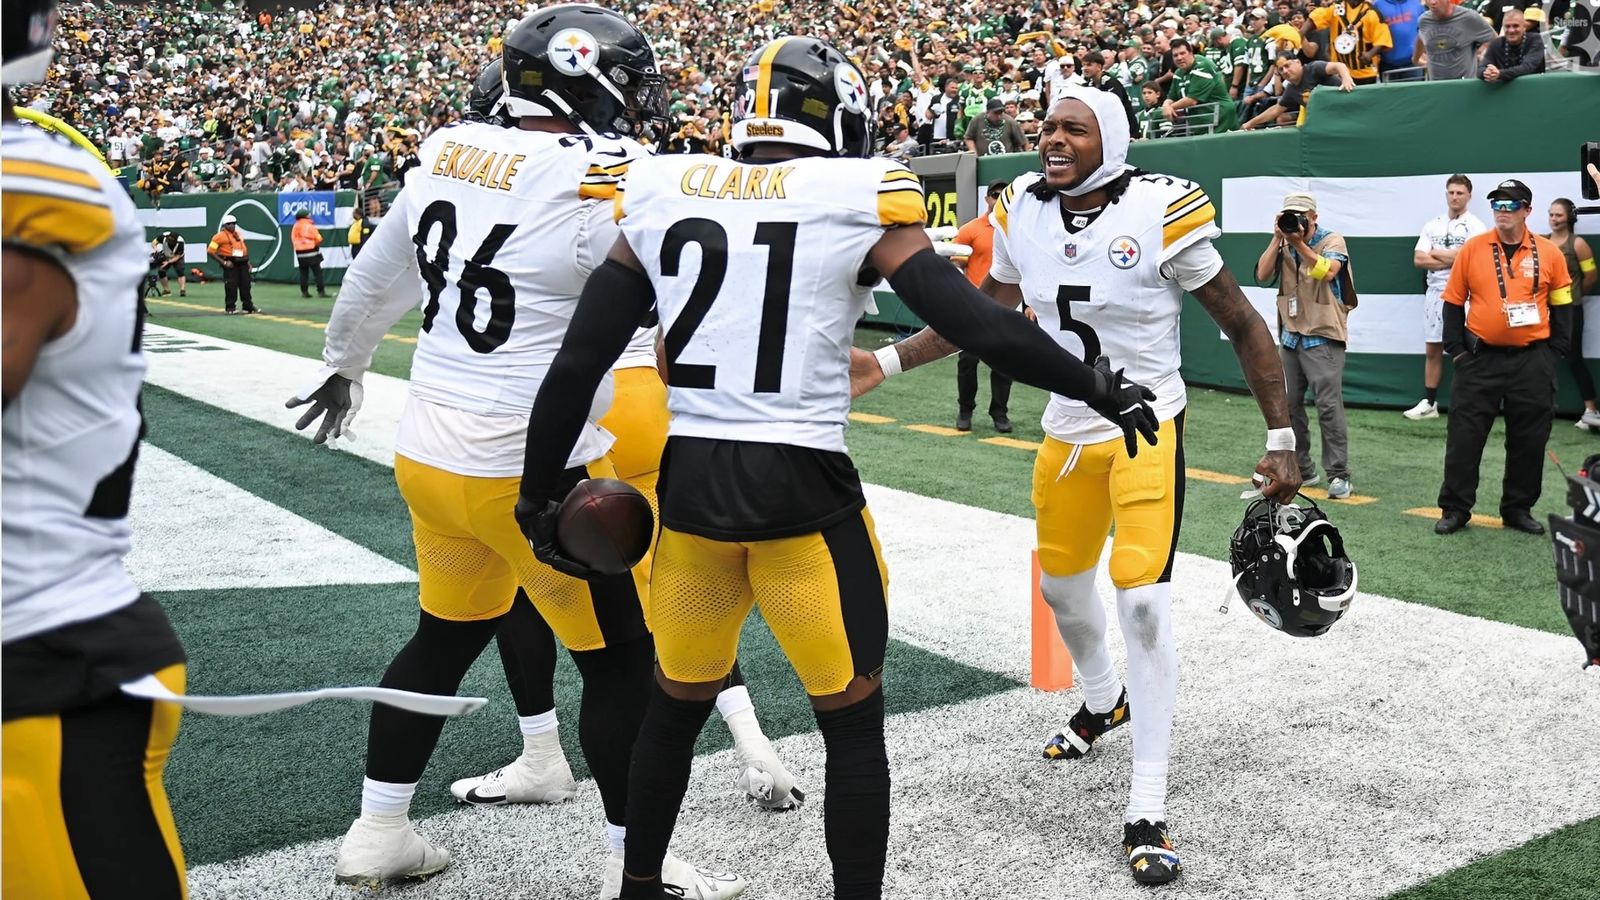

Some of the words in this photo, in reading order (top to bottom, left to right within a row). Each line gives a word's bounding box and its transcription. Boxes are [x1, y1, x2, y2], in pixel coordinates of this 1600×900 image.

[683, 138, 691, 154] 5
[746, 121, 784, 137] Steelers
[432, 141, 527, 191] EKUALE
[680, 163, 795, 199] CLARK
[312, 201, 331, 216] NFL
[927, 192, 957, 228] 25
[412, 200, 519, 354] 96
[660, 217, 799, 394] 21
[1056, 285, 1102, 364] 5
